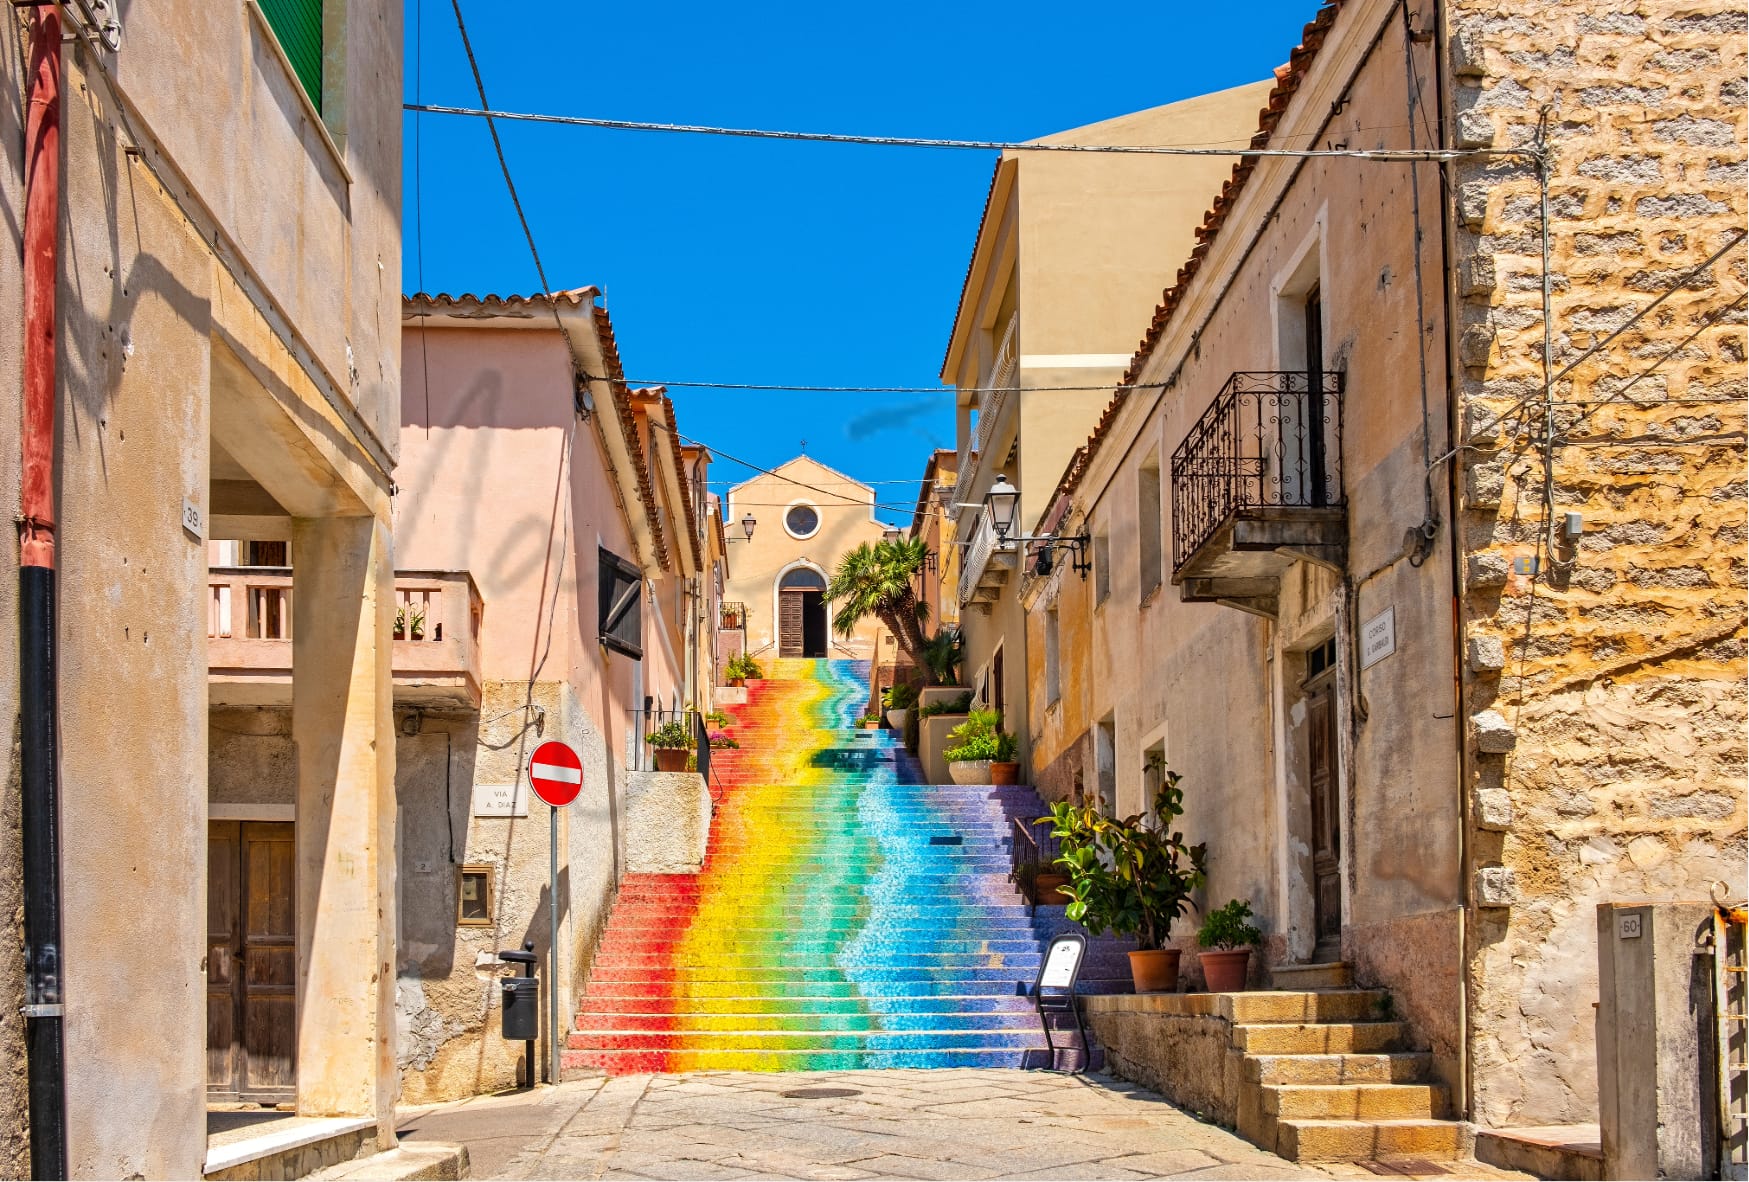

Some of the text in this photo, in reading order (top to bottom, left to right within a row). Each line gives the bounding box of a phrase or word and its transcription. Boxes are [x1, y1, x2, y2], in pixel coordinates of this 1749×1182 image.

[187, 506, 198, 527] 39
[1368, 621, 1386, 638] CORSO
[420, 863, 426, 871] 2
[1623, 920, 1637, 932] 60
